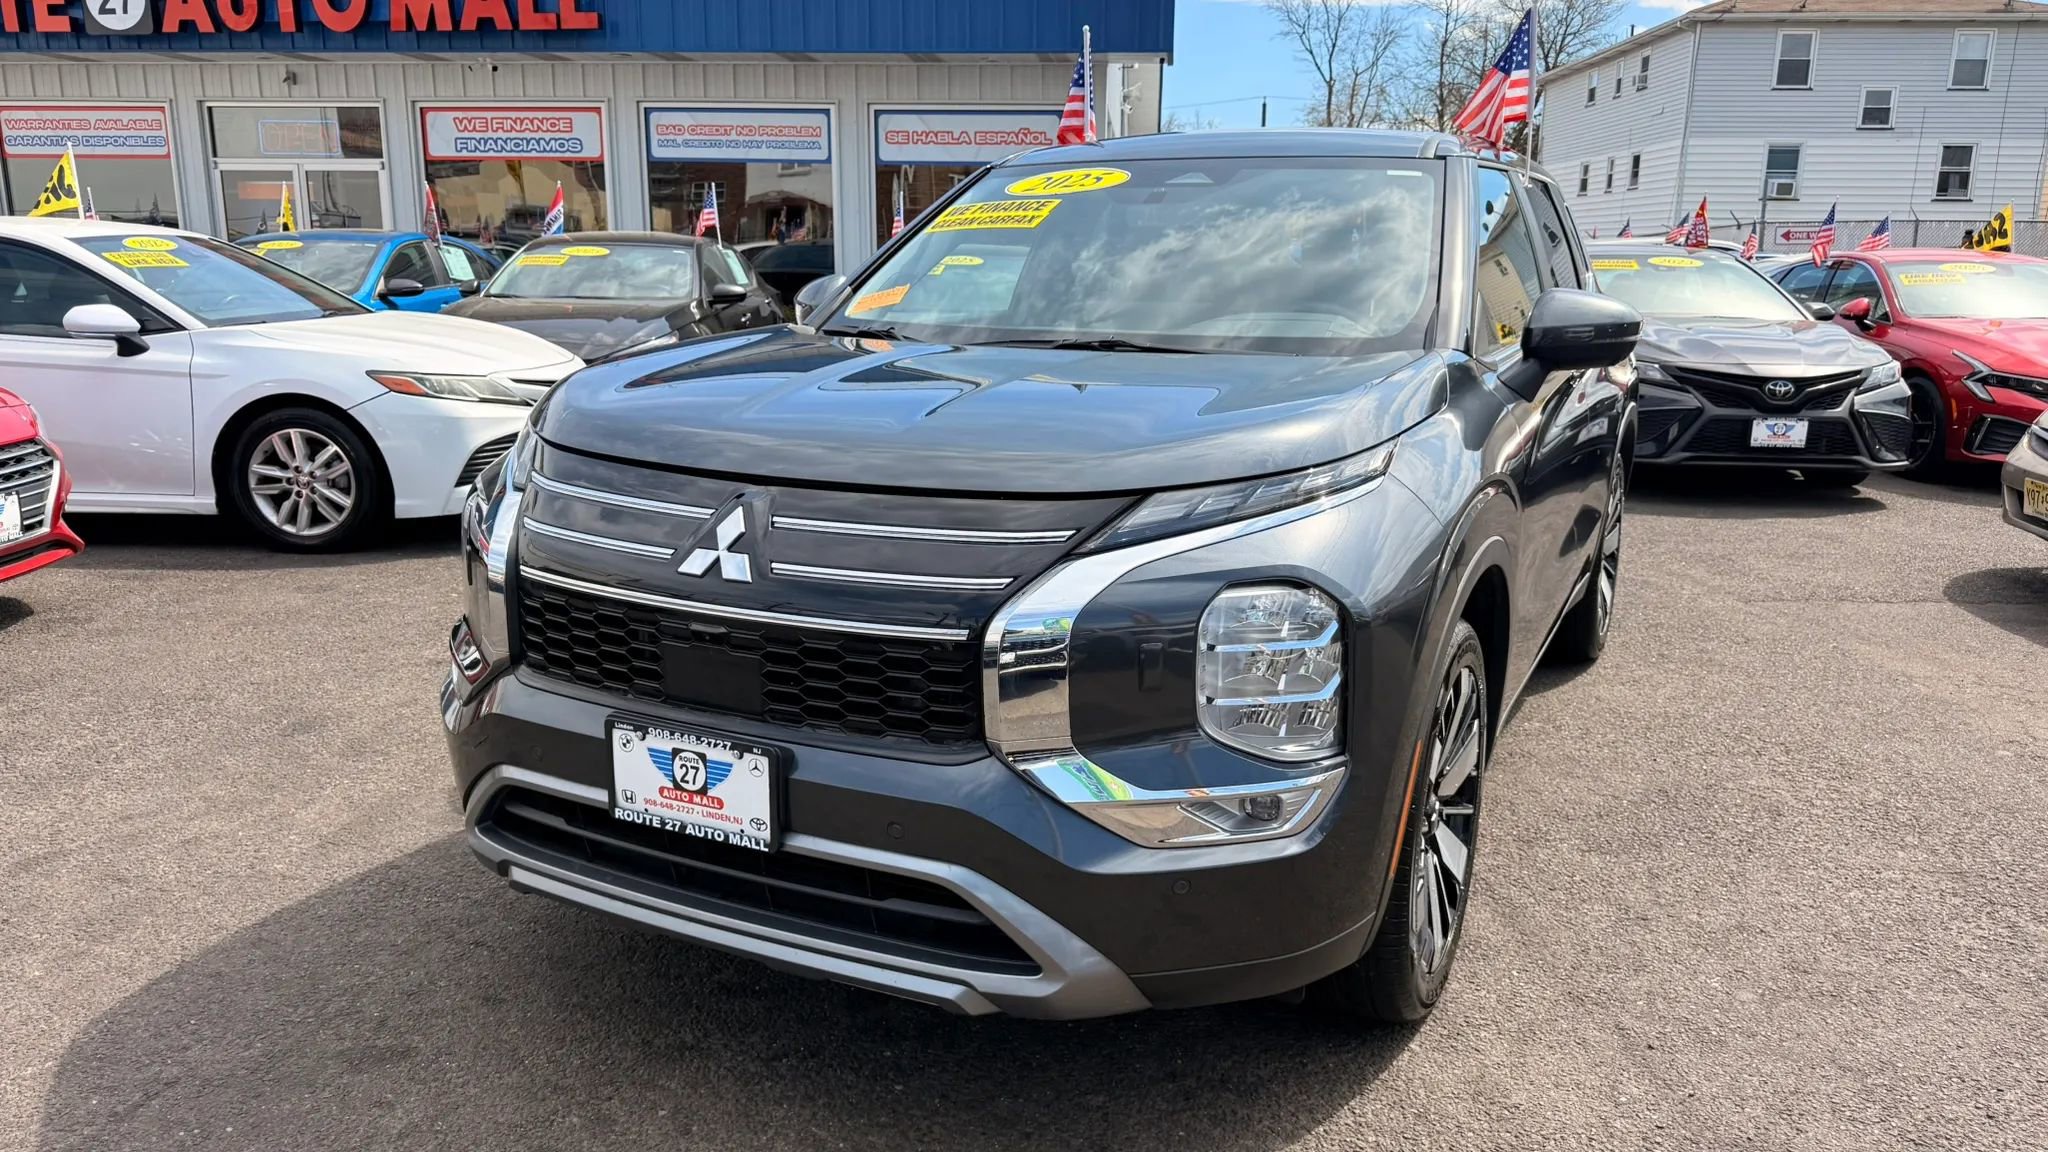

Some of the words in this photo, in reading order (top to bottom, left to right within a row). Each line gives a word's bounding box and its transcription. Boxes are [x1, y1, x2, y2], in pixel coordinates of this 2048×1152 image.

[5, 119, 90, 131] WARRANTIES
[94, 119, 162, 131] AVAILABLE
[453, 117, 488, 132] WE
[491, 117, 573, 133] FINANCE
[656, 124, 685, 136] BAD
[687, 125, 734, 136] CREDIT
[735, 125, 756, 136] NO
[758, 125, 822, 137] PROBLEM
[5, 135, 80, 147] GARANTIAS
[82, 136, 166, 148] DISPONIBLES
[657, 139, 681, 148] MAL
[682, 139, 724, 148] CREDITO
[725, 139, 741, 148] NO
[743, 139, 765, 149] HAY
[765, 140, 822, 149] PROBLEMA
[885, 130, 909, 144] SE
[912, 131, 971, 145] HABLA
[974, 127, 1053, 146] ESPAÑOL
[455, 137, 583, 153] FINANCIAMOS
[1023, 172, 1114, 192] 2025
[944, 204, 975, 217] WE
[975, 200, 1051, 214] FINANCE
[931, 216, 977, 229] CLEAN
[976, 215, 1040, 226] CARFAX
[1789, 231, 1808, 240] ONE
[615, 722, 634, 731] Linden
[648, 727, 731, 750] 908-648-2727
[678, 755, 700, 766] ROUTE
[679, 763, 700, 786] 27
[662, 787, 690, 802] AUTO
[693, 795, 722, 809] MALL
[643, 798, 695, 816] 908-648-2727
[615, 807, 662, 828] ROUTE
[665, 819, 682, 833] 27
[685, 824, 725, 843] AUTO
[728, 833, 769, 852] MALL
